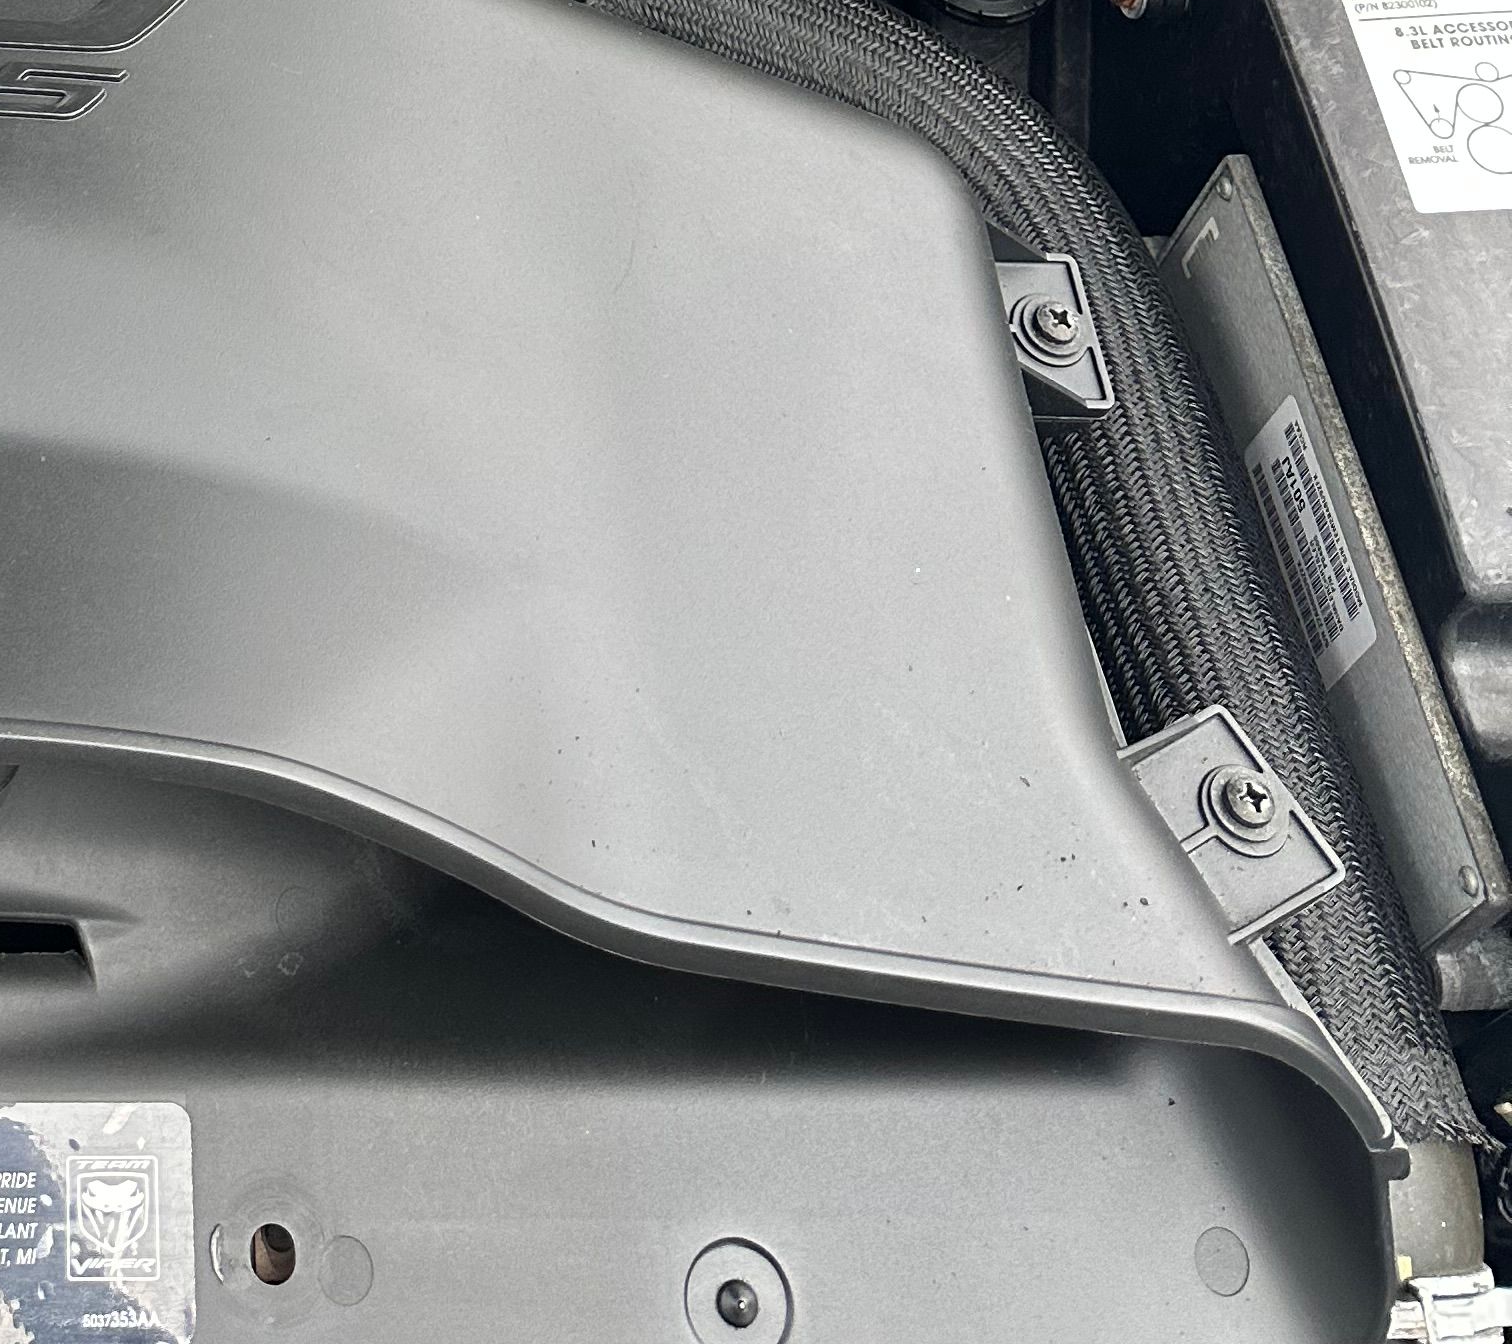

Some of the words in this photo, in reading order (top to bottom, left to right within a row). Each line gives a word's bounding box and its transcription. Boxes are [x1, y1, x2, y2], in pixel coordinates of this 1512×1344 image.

[1354, 2, 1379, 14] (P/N
[1394, 25, 1428, 37] 8.3L
[1433, 21, 1512, 36] ACCESSO
[1410, 38, 1444, 50] BELT
[1433, 144, 1454, 154] BELT
[1408, 155, 1458, 165] REMOVAL
[1281, 452, 1306, 514] 501AJ
[76, 1160, 151, 1170] TEAM
[16, 1247, 37, 1265] MI
[71, 1257, 157, 1275] VIPER
